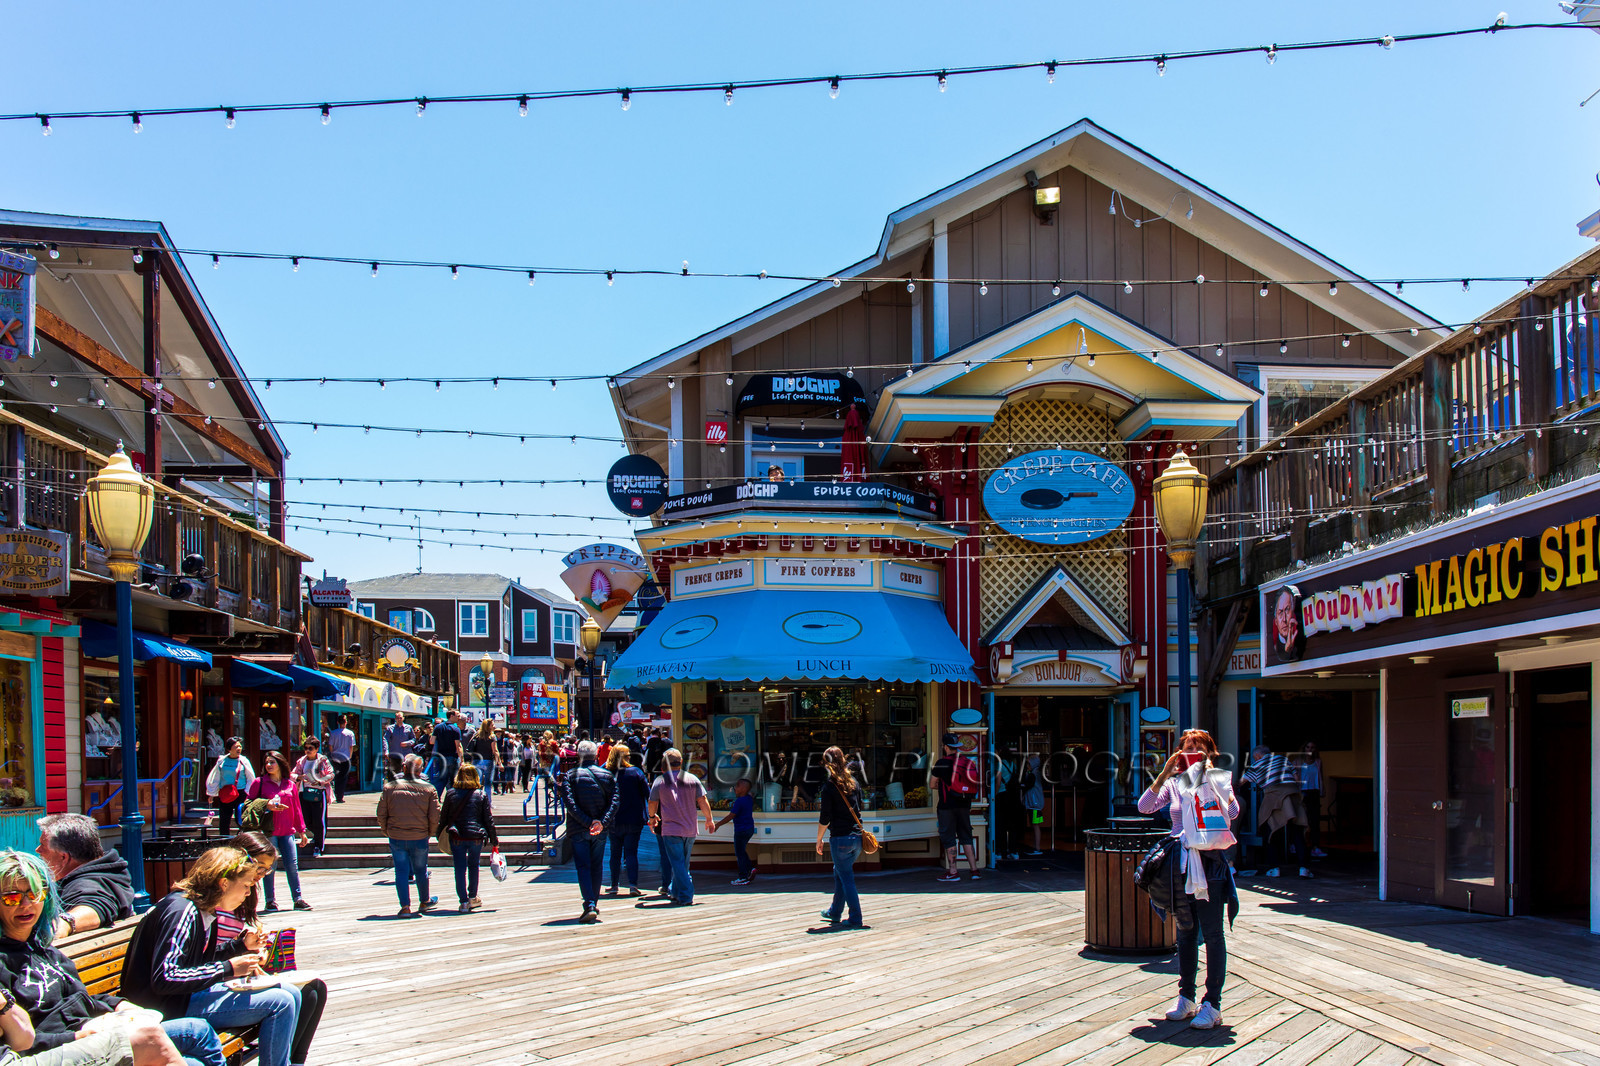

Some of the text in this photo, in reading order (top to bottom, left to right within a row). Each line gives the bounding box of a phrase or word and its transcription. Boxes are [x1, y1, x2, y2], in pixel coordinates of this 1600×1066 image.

[772, 376, 840, 394] DOUGHP
[707, 425, 726, 442] illy
[613, 475, 661, 488] DOUGHP
[737, 484, 778, 499] DOUGHP
[814, 486, 915, 504] EDIBLE COOKIE DOUGH
[687, 493, 713, 506] DOUGH
[1062, 517, 1107, 527] CREPES
[6, 534, 62, 552] FRANCISCO'S
[685, 568, 743, 585] FRENCH CREPES
[781, 566, 856, 577] FINE COFFEES
[900, 572, 922, 584] CREPES
[1303, 515, 1600, 626] HOUDINI'S MAGIC SH
[636, 662, 696, 677] BREAKFAST
[797, 660, 851, 672] LUNCH
[930, 663, 967, 675] DINNER
[1034, 662, 1082, 682] BONJOUR
